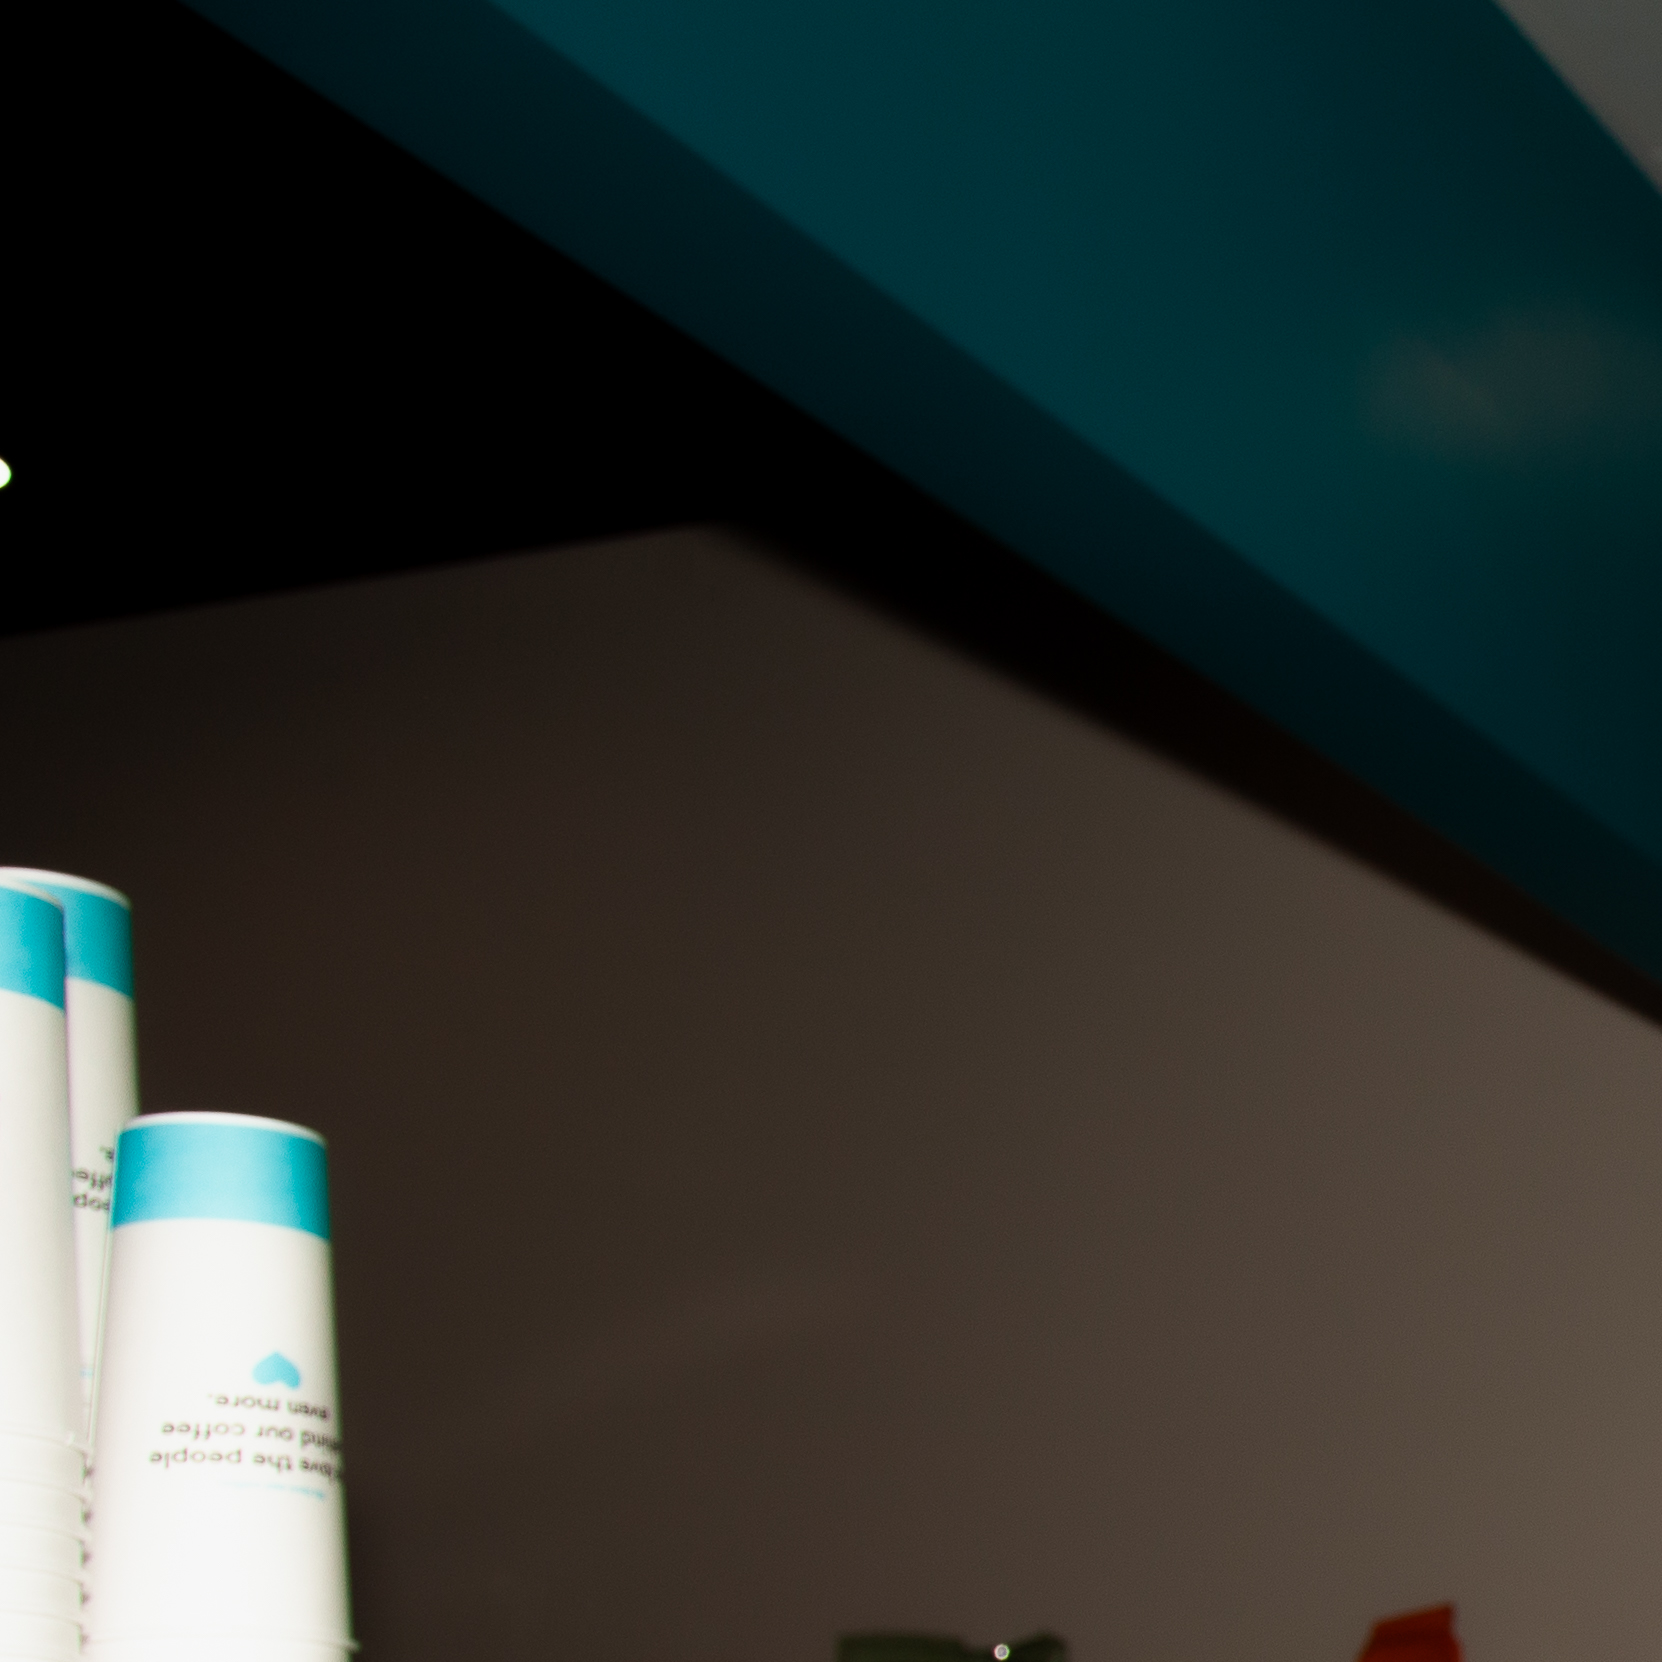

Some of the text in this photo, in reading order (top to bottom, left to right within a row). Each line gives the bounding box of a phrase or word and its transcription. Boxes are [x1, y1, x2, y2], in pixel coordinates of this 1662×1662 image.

[208, 1394, 281, 1413] more.
[161, 1421, 246, 1441] coffee
[256, 1425, 293, 1442] our
[148, 1448, 242, 1469] people
[252, 1453, 292, 1475] the
